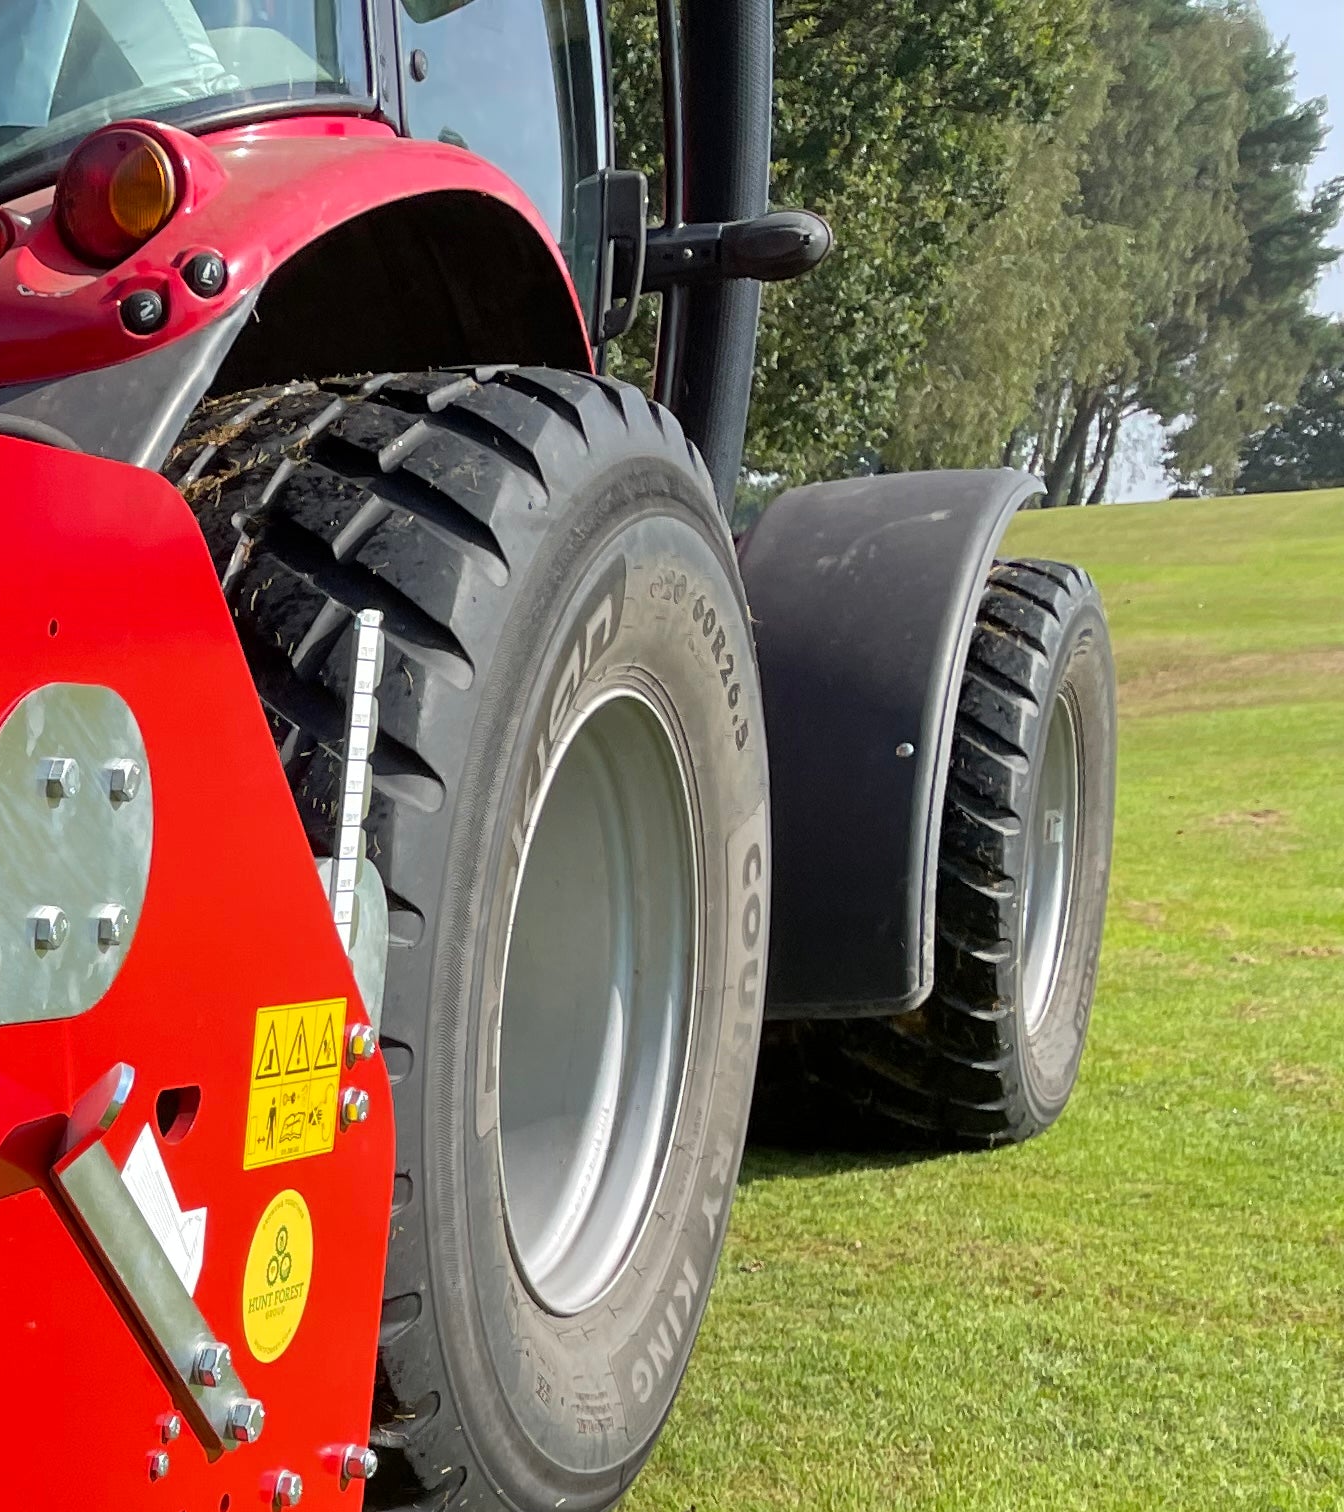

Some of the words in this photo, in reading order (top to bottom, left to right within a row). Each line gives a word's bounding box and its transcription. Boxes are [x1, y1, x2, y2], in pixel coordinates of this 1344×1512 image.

[247, 1291, 274, 1314] HUNT
[274, 1281, 305, 1306] FOREST
[630, 1255, 700, 1404] KING
